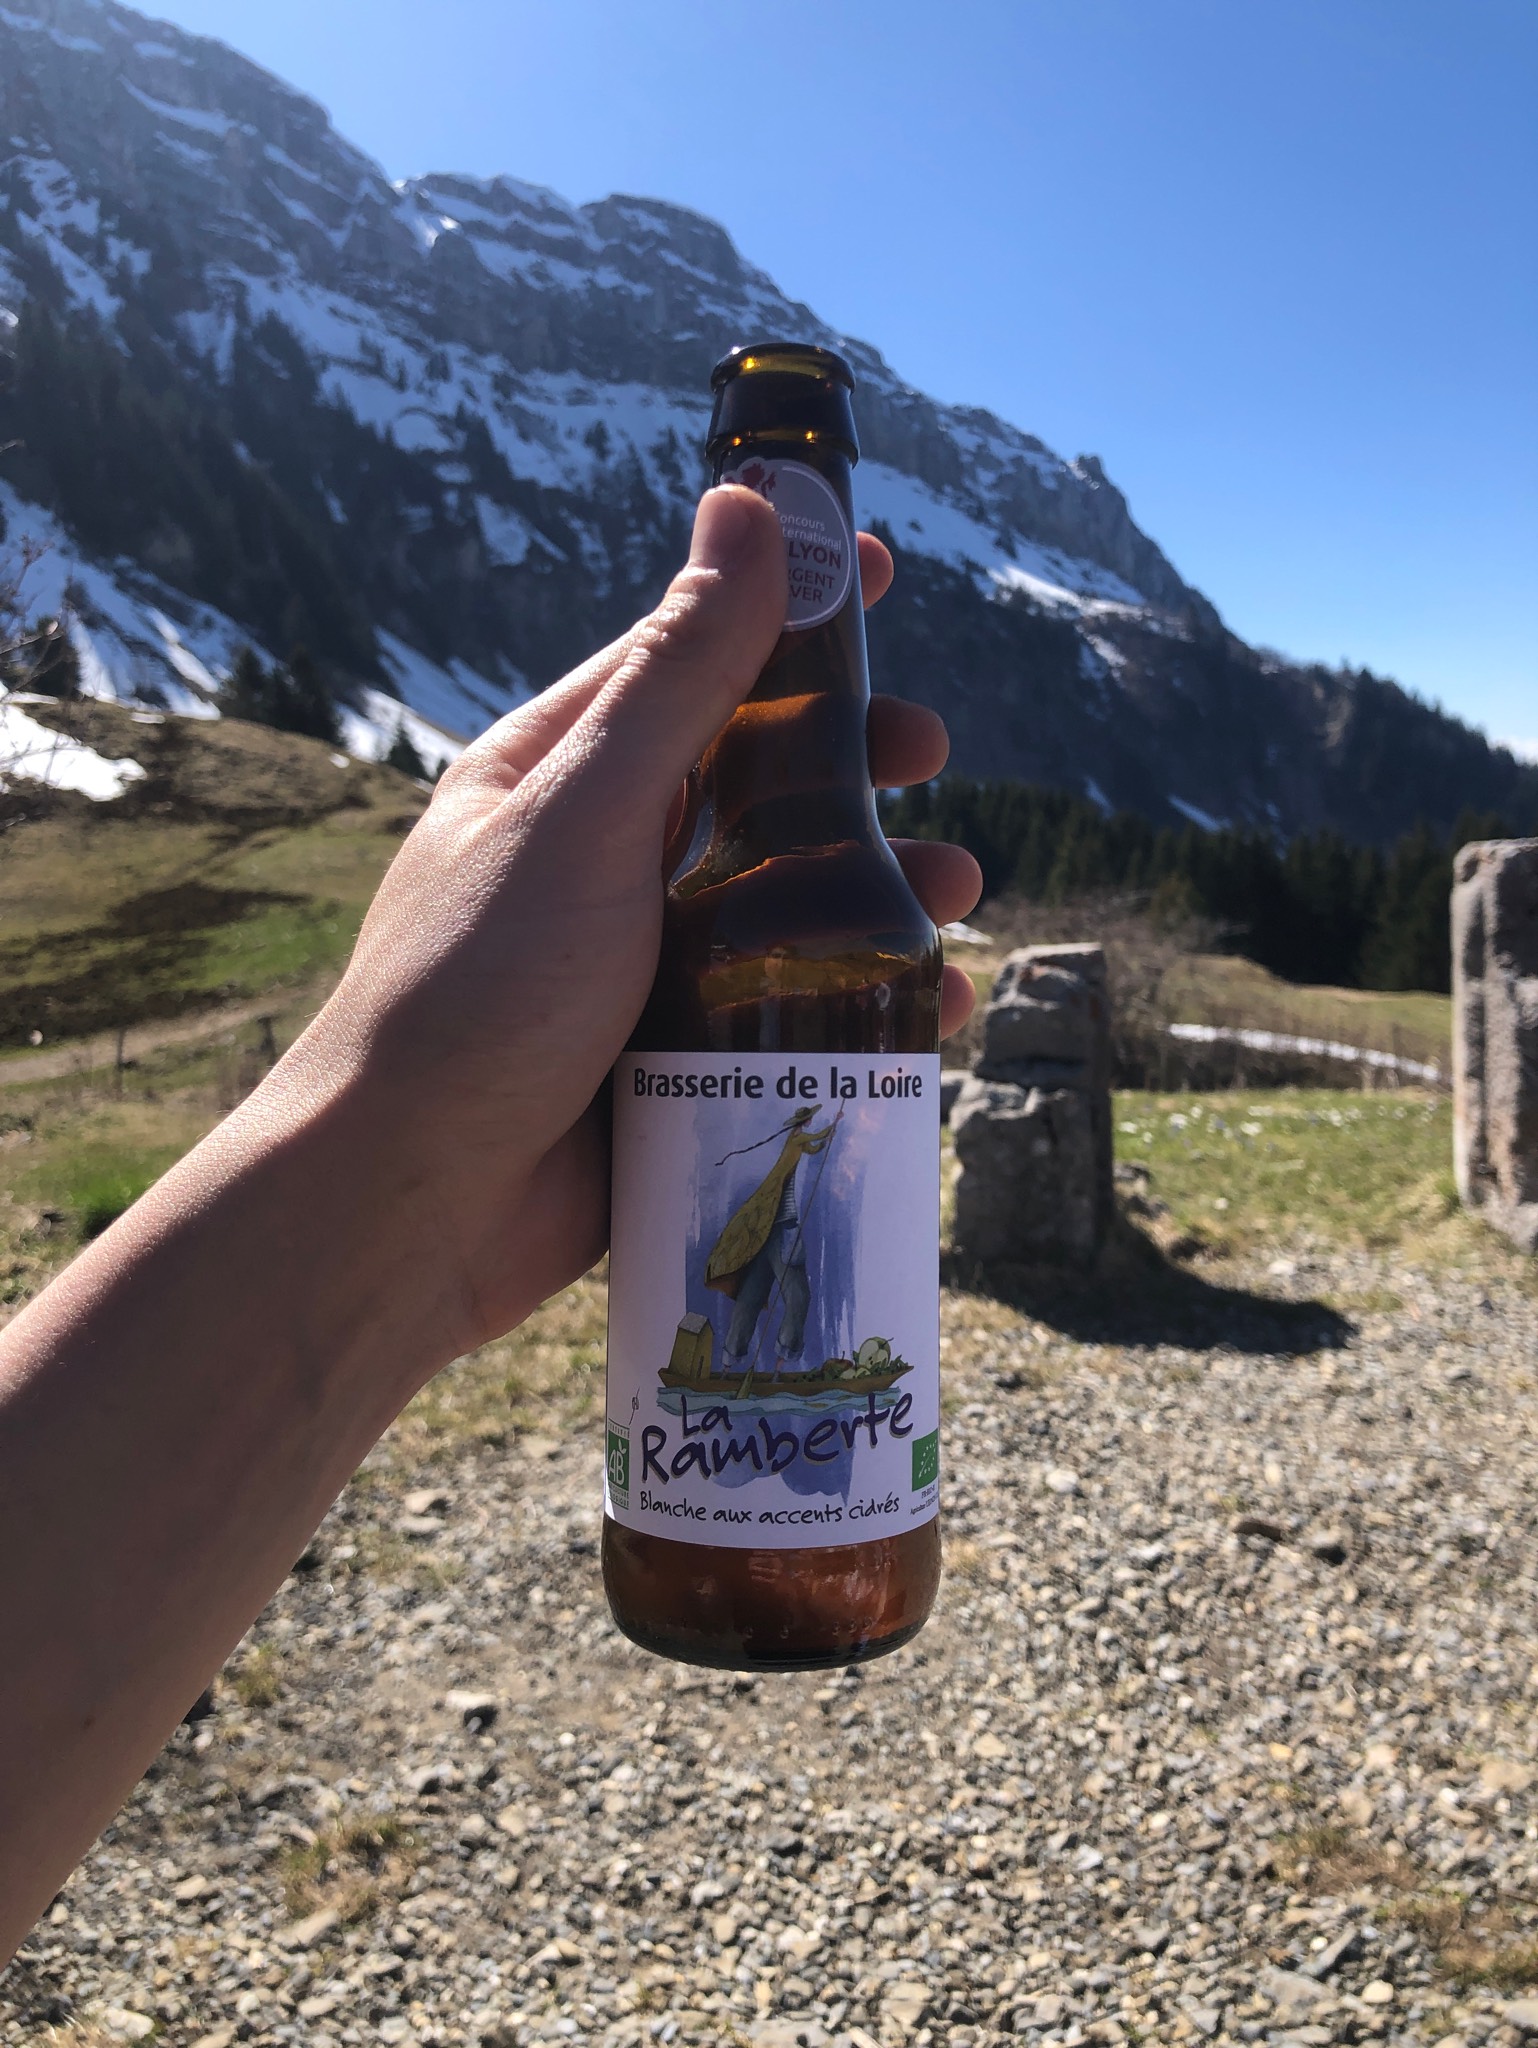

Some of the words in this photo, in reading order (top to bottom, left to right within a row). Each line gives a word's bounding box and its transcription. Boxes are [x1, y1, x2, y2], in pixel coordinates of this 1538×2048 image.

[779, 513, 825, 532] oncours
[782, 526, 842, 551] ternational
[788, 541, 841, 569] LYON
[787, 567, 836, 589] GENT
[789, 584, 823, 604] VER
[634, 1066, 764, 1099] Brasserie
[776, 1066, 818, 1099] de
[831, 1066, 857, 1099] la
[868, 1067, 922, 1099] Loire
[680, 1394, 734, 1438] La
[641, 1392, 914, 1484] Ramberte
[608, 1449, 625, 1486] AB
[640, 1490, 707, 1521] Blanche
[713, 1506, 752, 1523] aux
[758, 1504, 844, 1526] accents
[848, 1491, 900, 1520] cidrés
